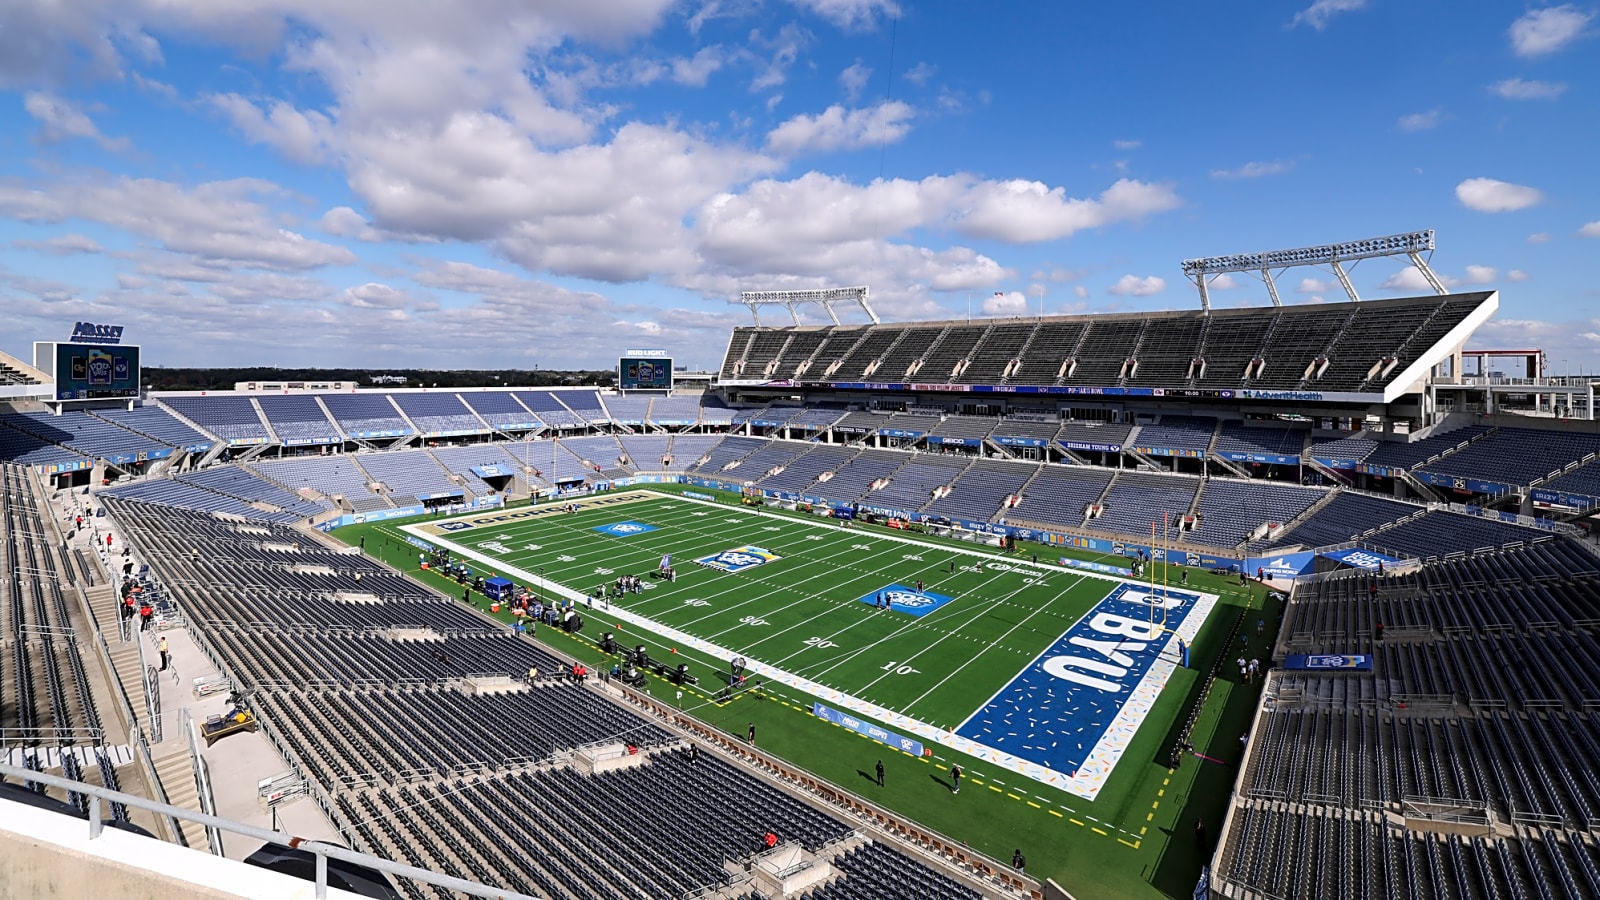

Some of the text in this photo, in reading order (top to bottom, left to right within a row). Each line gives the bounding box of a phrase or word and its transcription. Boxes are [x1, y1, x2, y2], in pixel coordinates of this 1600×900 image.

[1254, 390, 1323, 400] AdventHealth
[1067, 442, 1091, 450] BRIGHAM
[1454, 479, 1464, 488] 25
[473, 503, 586, 525] GEORGA
[738, 615, 765, 626] 30
[802, 636, 833, 648] 20
[1042, 612, 1166, 693] BYU
[880, 661, 914, 675] 10
